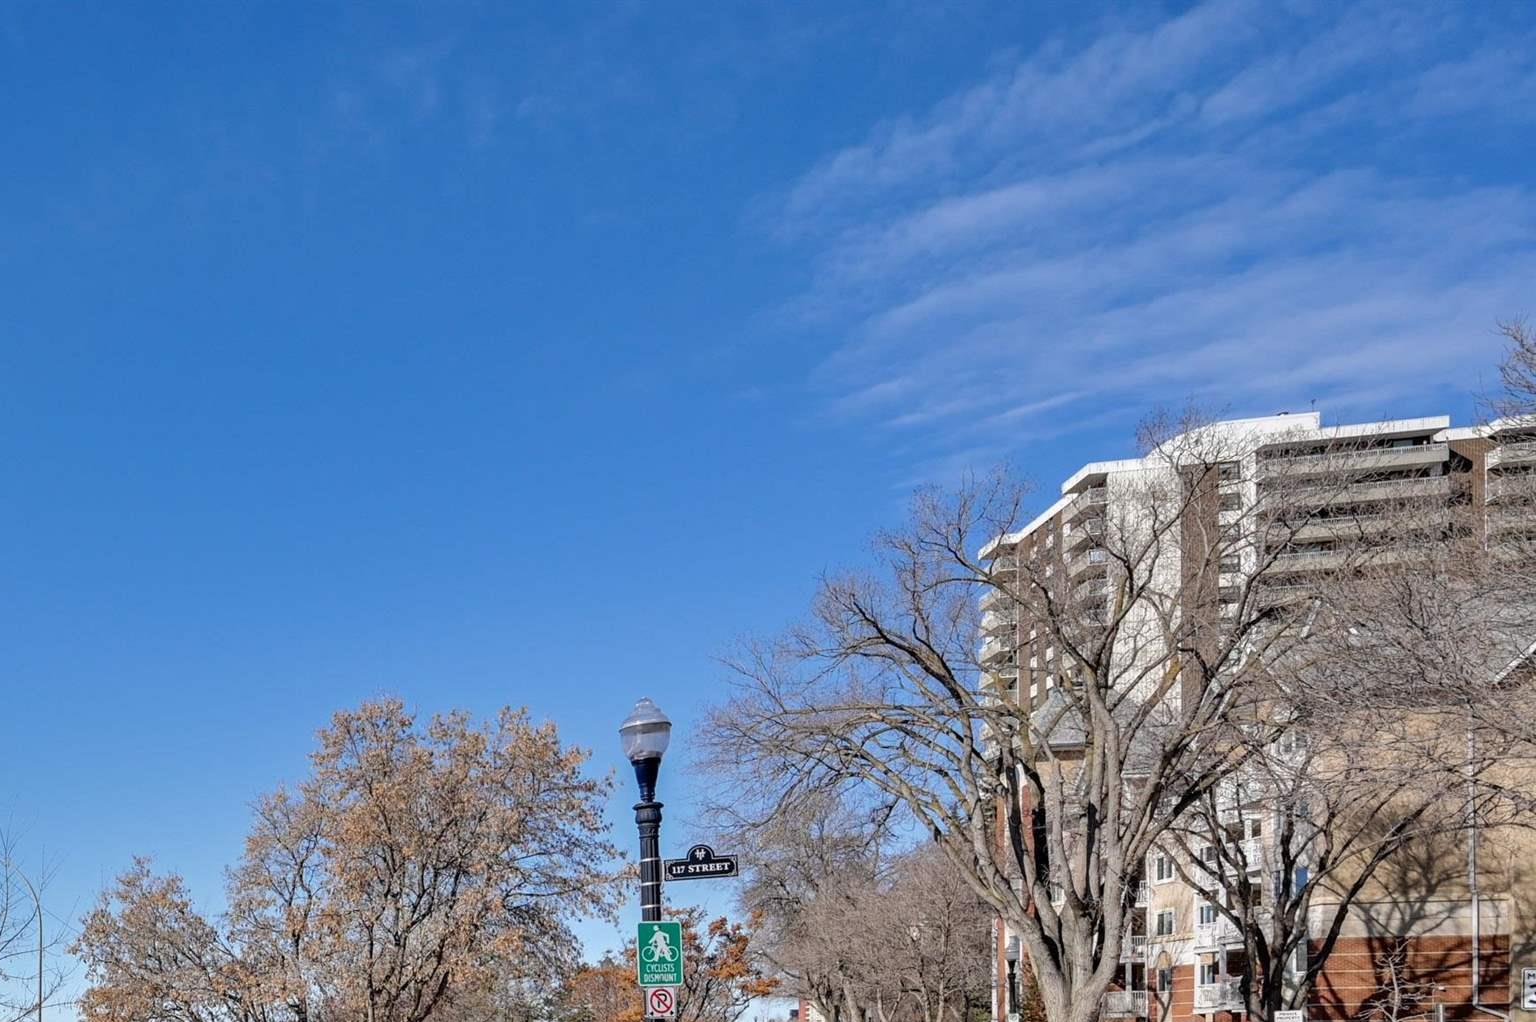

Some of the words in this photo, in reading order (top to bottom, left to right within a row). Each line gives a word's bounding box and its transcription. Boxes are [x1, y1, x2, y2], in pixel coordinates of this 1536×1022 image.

[672, 865, 685, 874] 117
[688, 862, 730, 873] STREET
[646, 963, 675, 972] CYCLISTS
[644, 973, 677, 983] DISMOUNT
